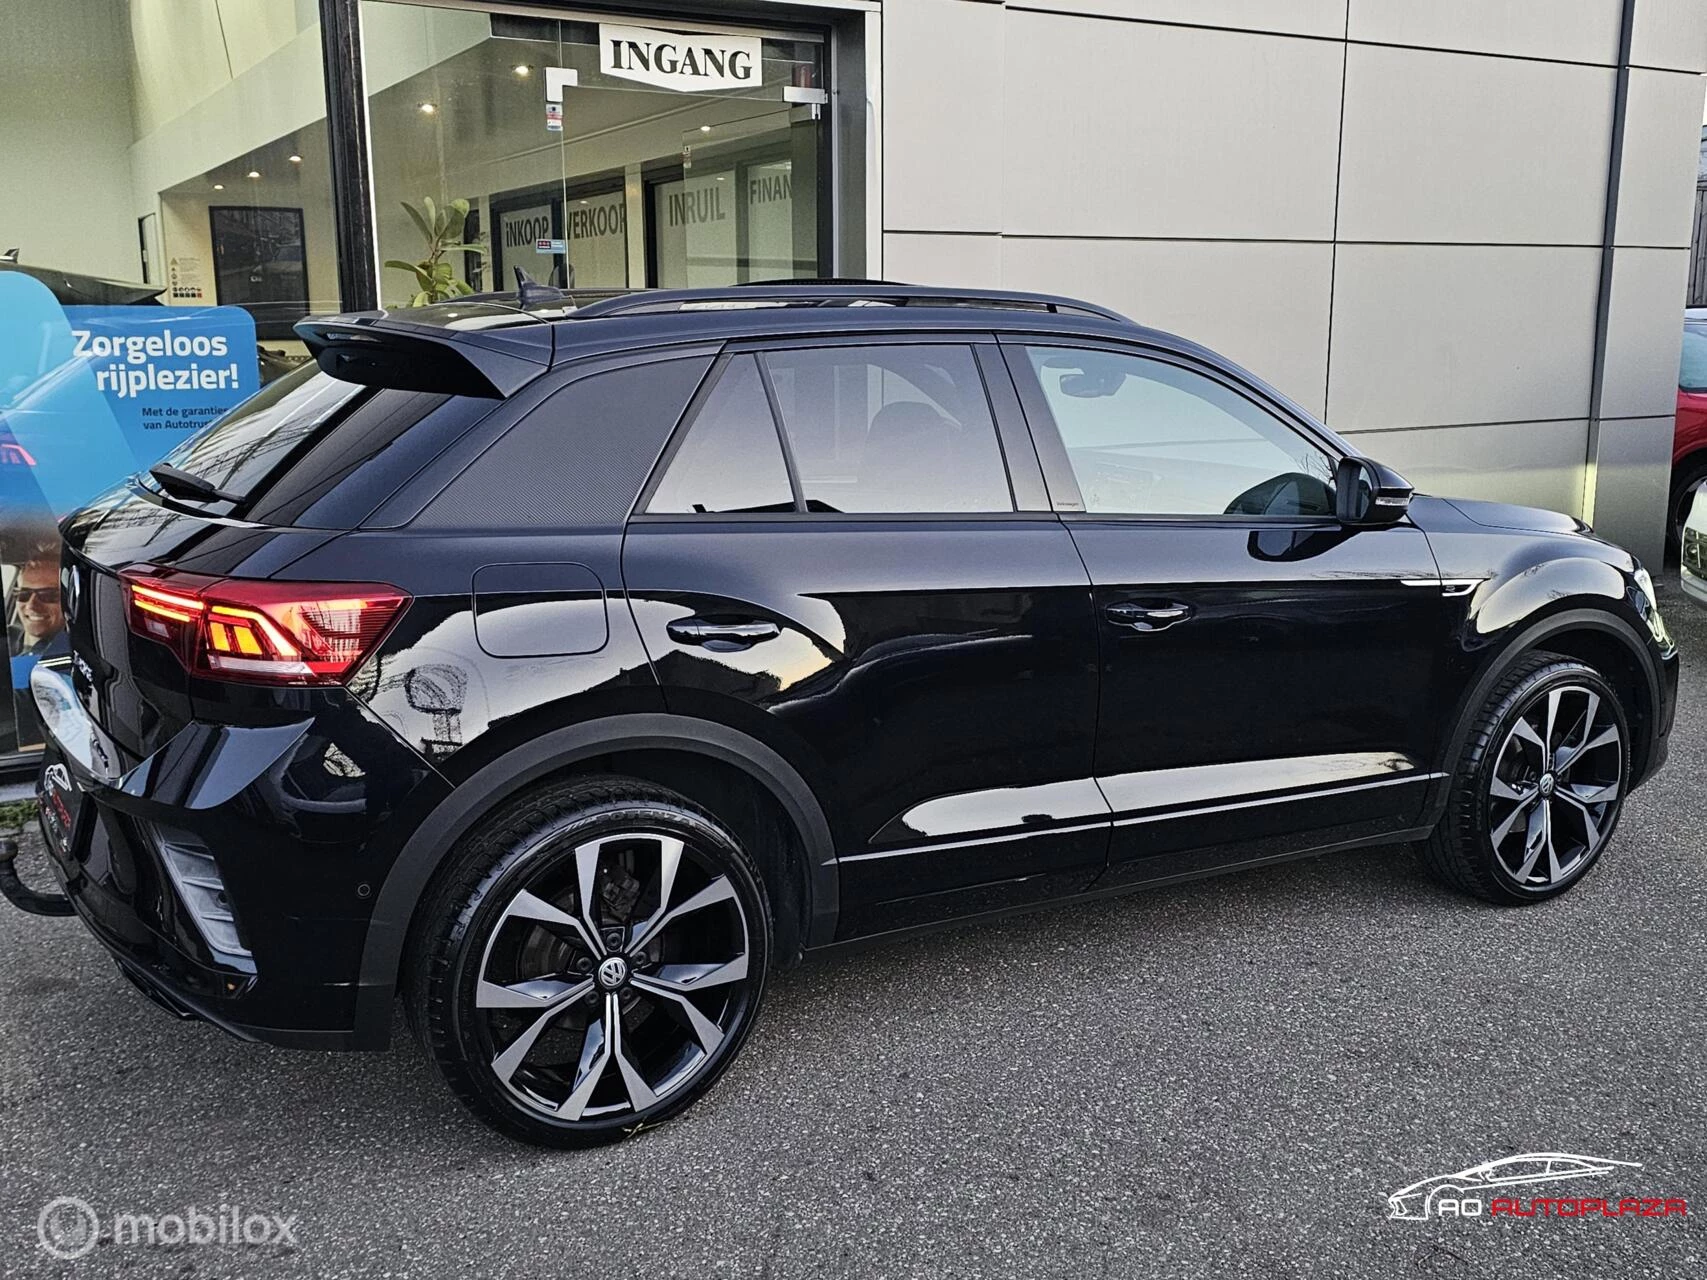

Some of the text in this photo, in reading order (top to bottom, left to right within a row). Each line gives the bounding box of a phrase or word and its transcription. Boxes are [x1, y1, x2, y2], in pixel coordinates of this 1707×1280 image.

[610, 39, 752, 80] INGANG
[668, 187, 726, 227] INRUIL
[71, 329, 228, 364] Zorgeloos
[96, 363, 239, 398] rijplezier!
[142, 407, 163, 417] Met
[166, 406, 179, 416] de
[143, 421, 162, 430] van
